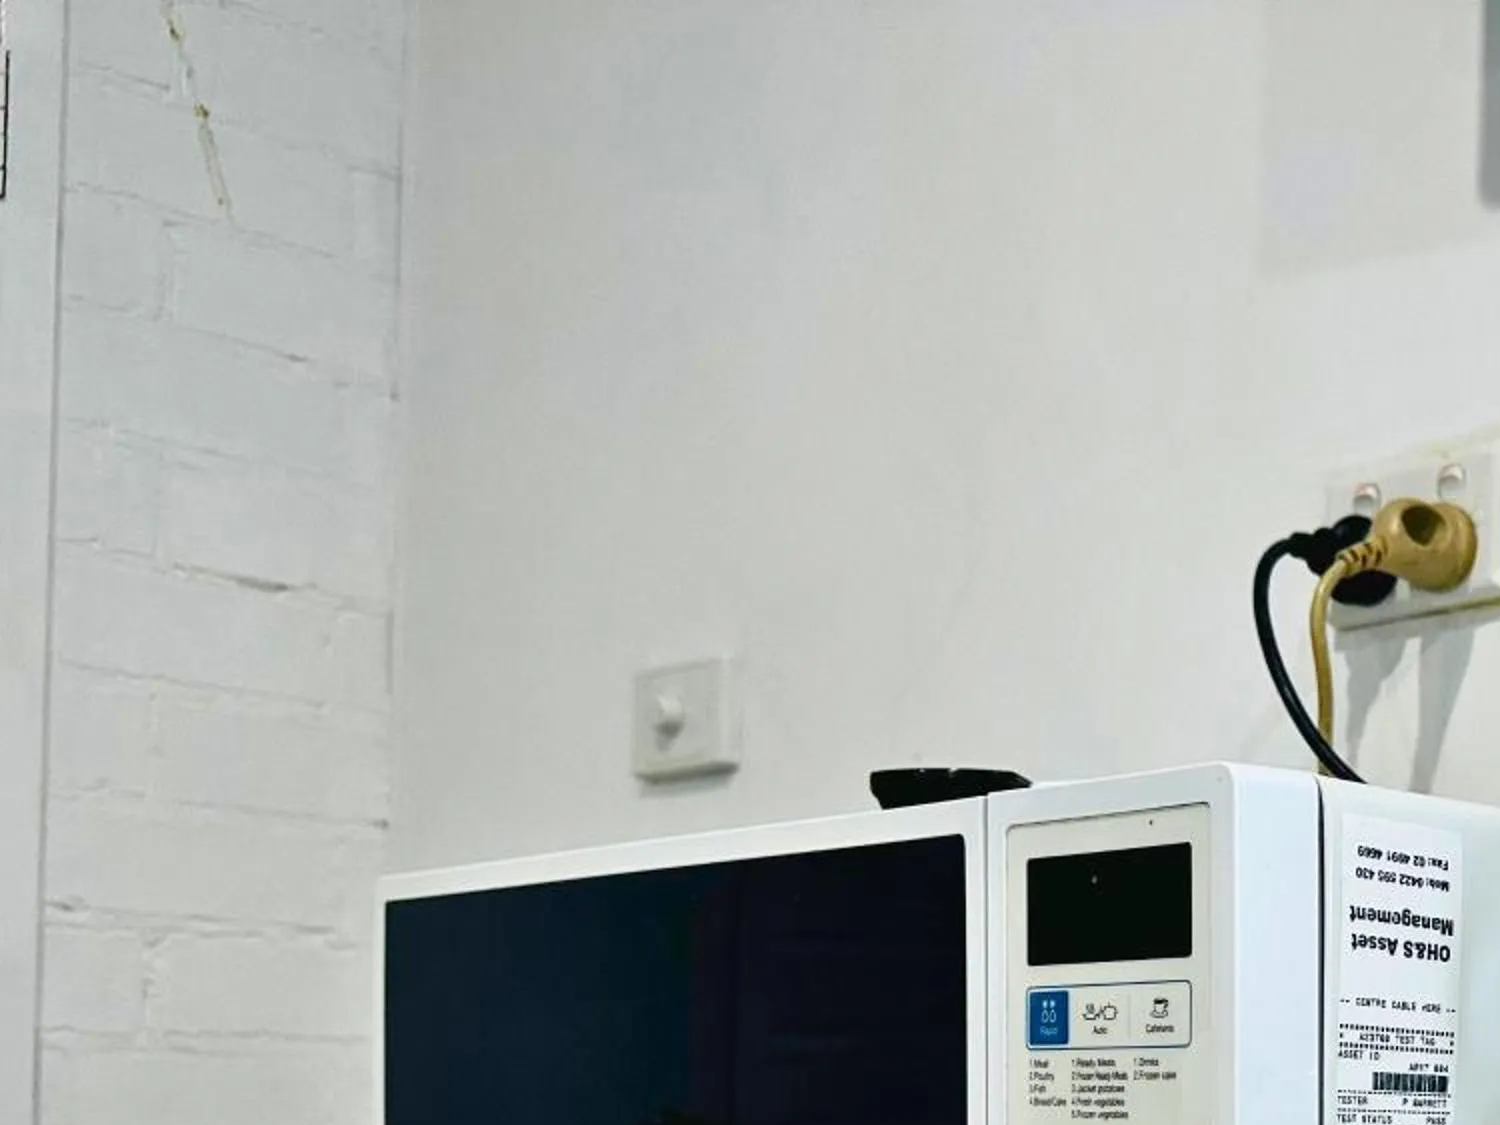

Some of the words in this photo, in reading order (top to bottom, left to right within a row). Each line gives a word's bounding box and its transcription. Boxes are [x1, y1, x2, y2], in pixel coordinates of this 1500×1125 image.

[1349, 905, 1454, 936] Management
[1351, 933, 1398, 956] Asset
[1403, 940, 1451, 962] OH&S
